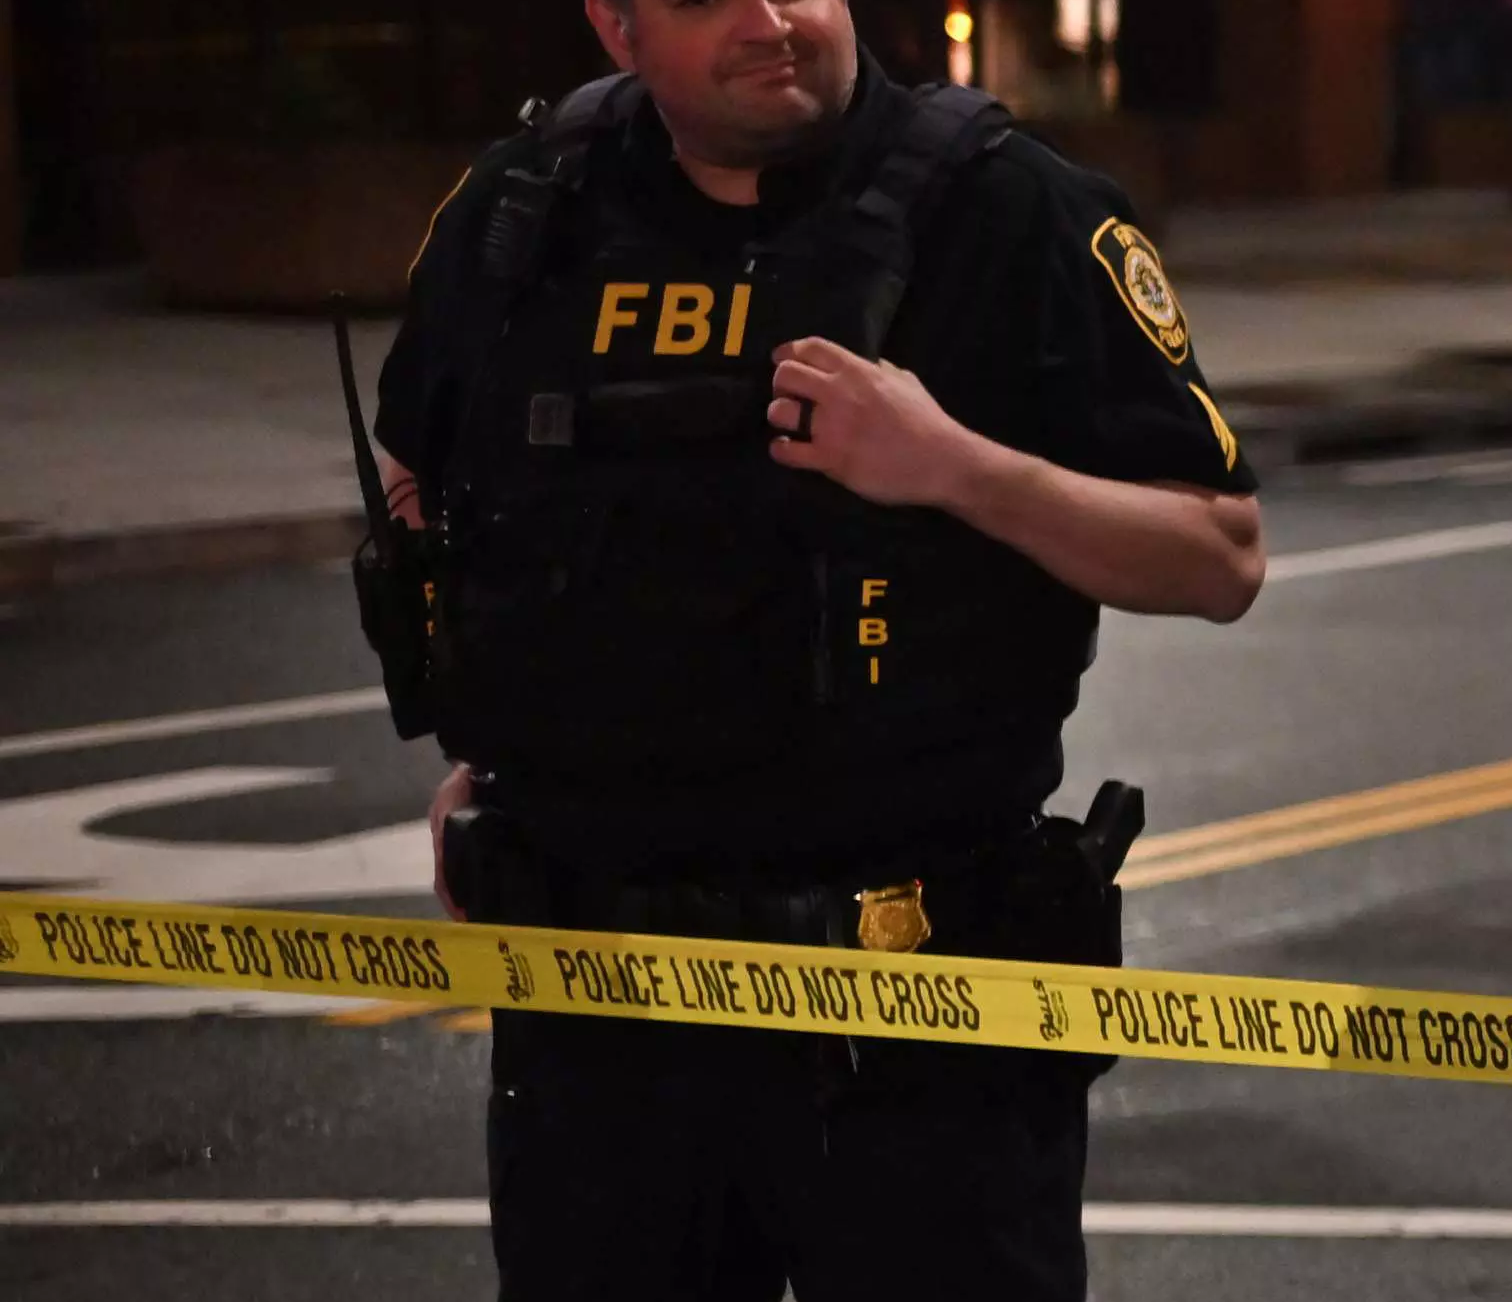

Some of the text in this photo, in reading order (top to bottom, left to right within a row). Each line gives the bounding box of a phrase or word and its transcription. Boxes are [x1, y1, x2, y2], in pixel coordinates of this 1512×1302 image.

[592, 282, 753, 356] FBI
[858, 578, 888, 684] FBI
[34, 911, 152, 968] POLICE
[146, 920, 226, 974] LINE
[220, 924, 273, 978] DO
[271, 928, 339, 982] NOT
[340, 931, 451, 992] CROSS
[553, 948, 671, 1007] POLICE
[669, 956, 747, 1014] LINE
[745, 962, 796, 1019] DO
[797, 965, 865, 1022] NOT
[870, 970, 980, 1032] CROSS
[1090, 986, 1209, 1048] POLICE
[1210, 995, 1289, 1054] LINE
[1288, 1000, 1340, 1059] DO
[1343, 1004, 1410, 1064] NOT
